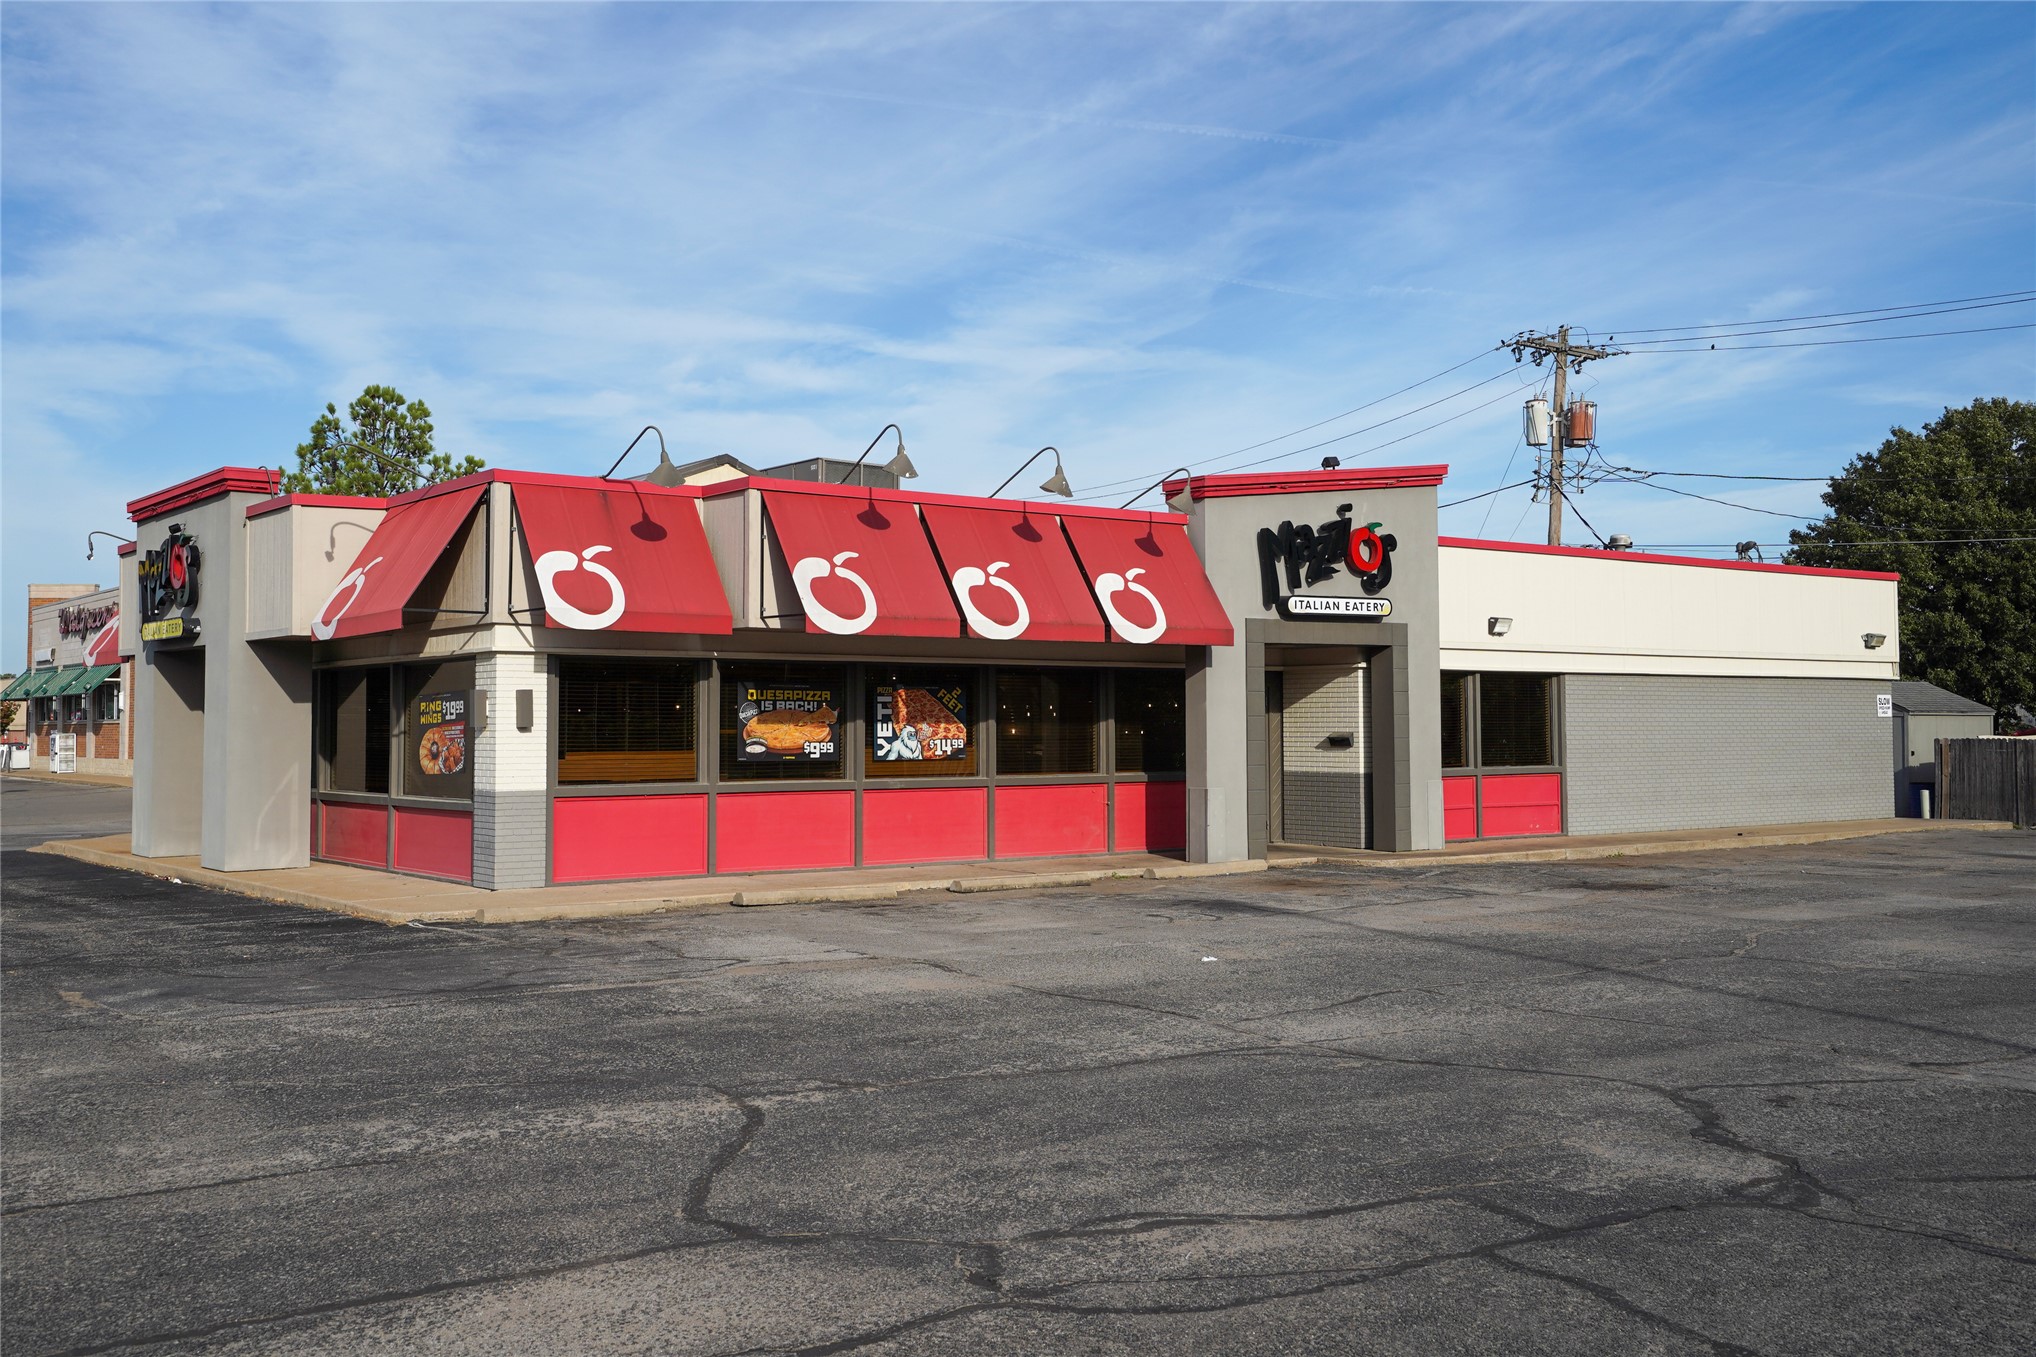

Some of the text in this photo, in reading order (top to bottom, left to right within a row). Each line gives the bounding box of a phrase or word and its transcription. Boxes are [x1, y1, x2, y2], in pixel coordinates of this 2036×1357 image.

[1294, 599, 1385, 612] ITALIAN EATERY
[747, 689, 831, 701] QUESAPIZZA
[952, 686, 962, 698] 2
[420, 701, 442, 712] RING
[760, 701, 773, 711] IS
[937, 689, 963, 713] FEET
[420, 713, 442, 725] WINGS
[877, 696, 893, 756] YETI
